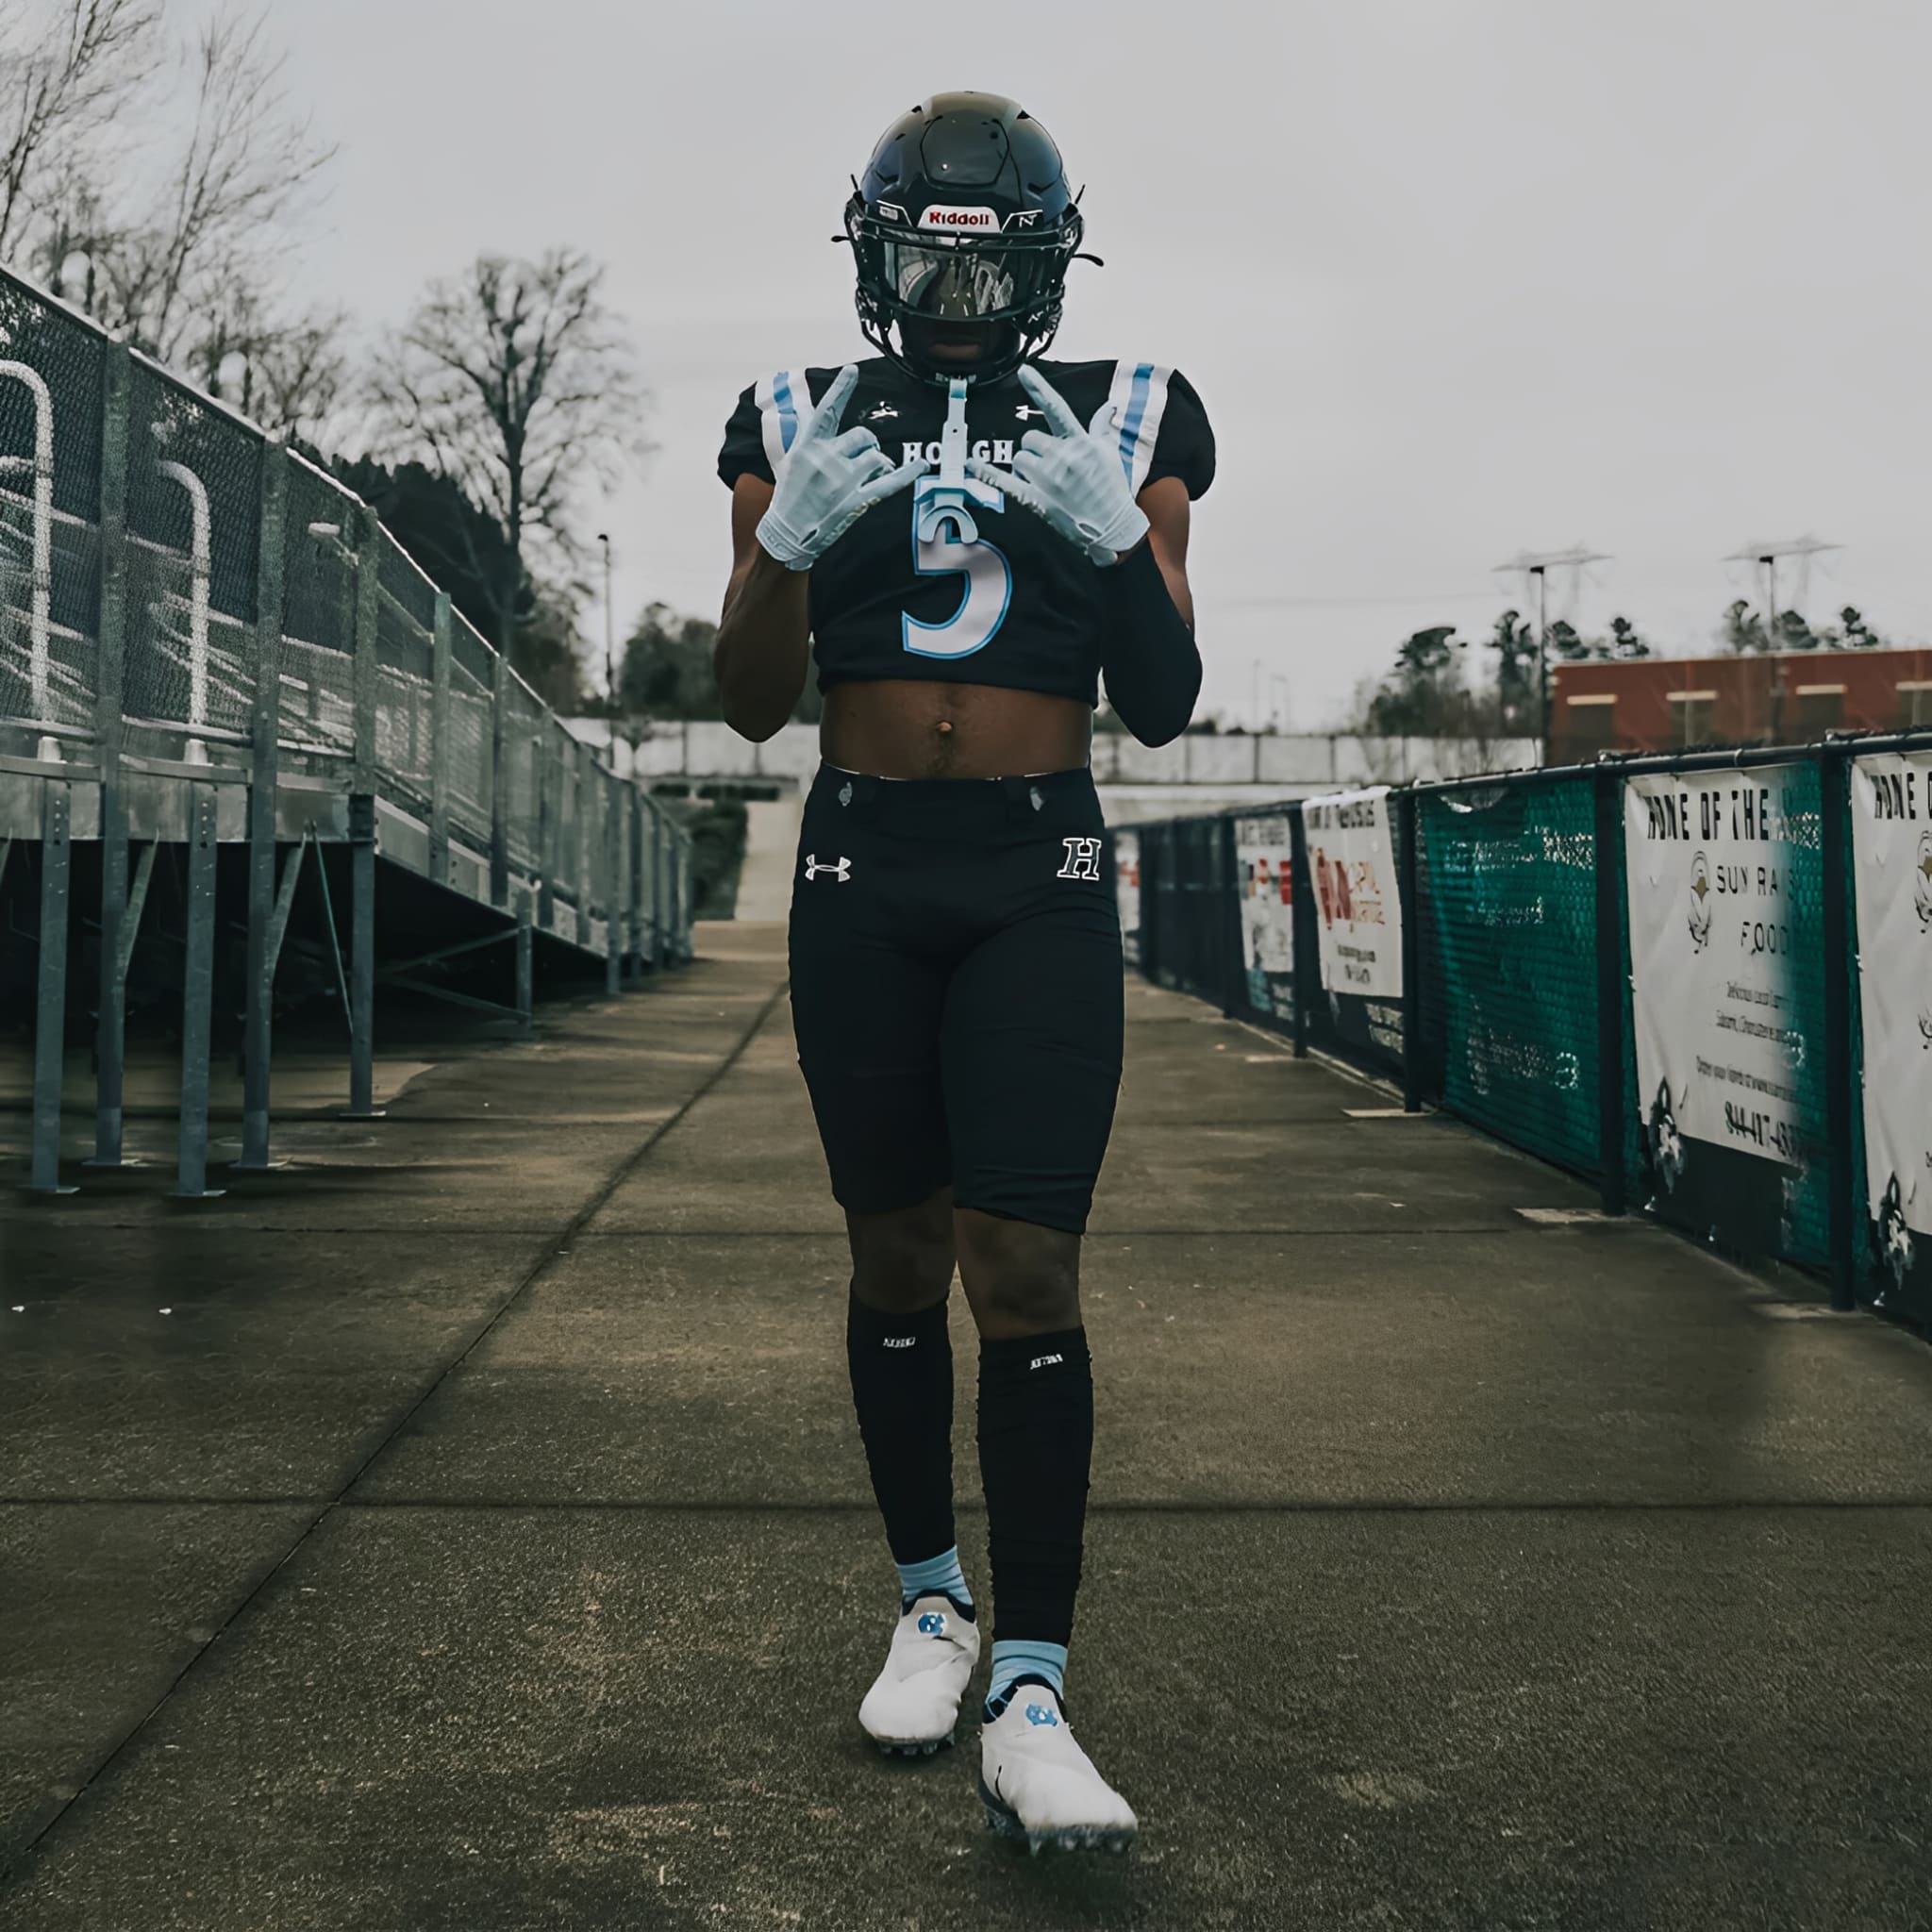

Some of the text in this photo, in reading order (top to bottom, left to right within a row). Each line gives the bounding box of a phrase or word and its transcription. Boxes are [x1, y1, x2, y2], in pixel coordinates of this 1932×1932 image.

[902, 440, 1015, 467] HOGH
[901, 475, 1013, 660] 5
[1700, 791, 1722, 841] OF
[1730, 788, 1770, 841] THE
[1057, 837, 1103, 882] H
